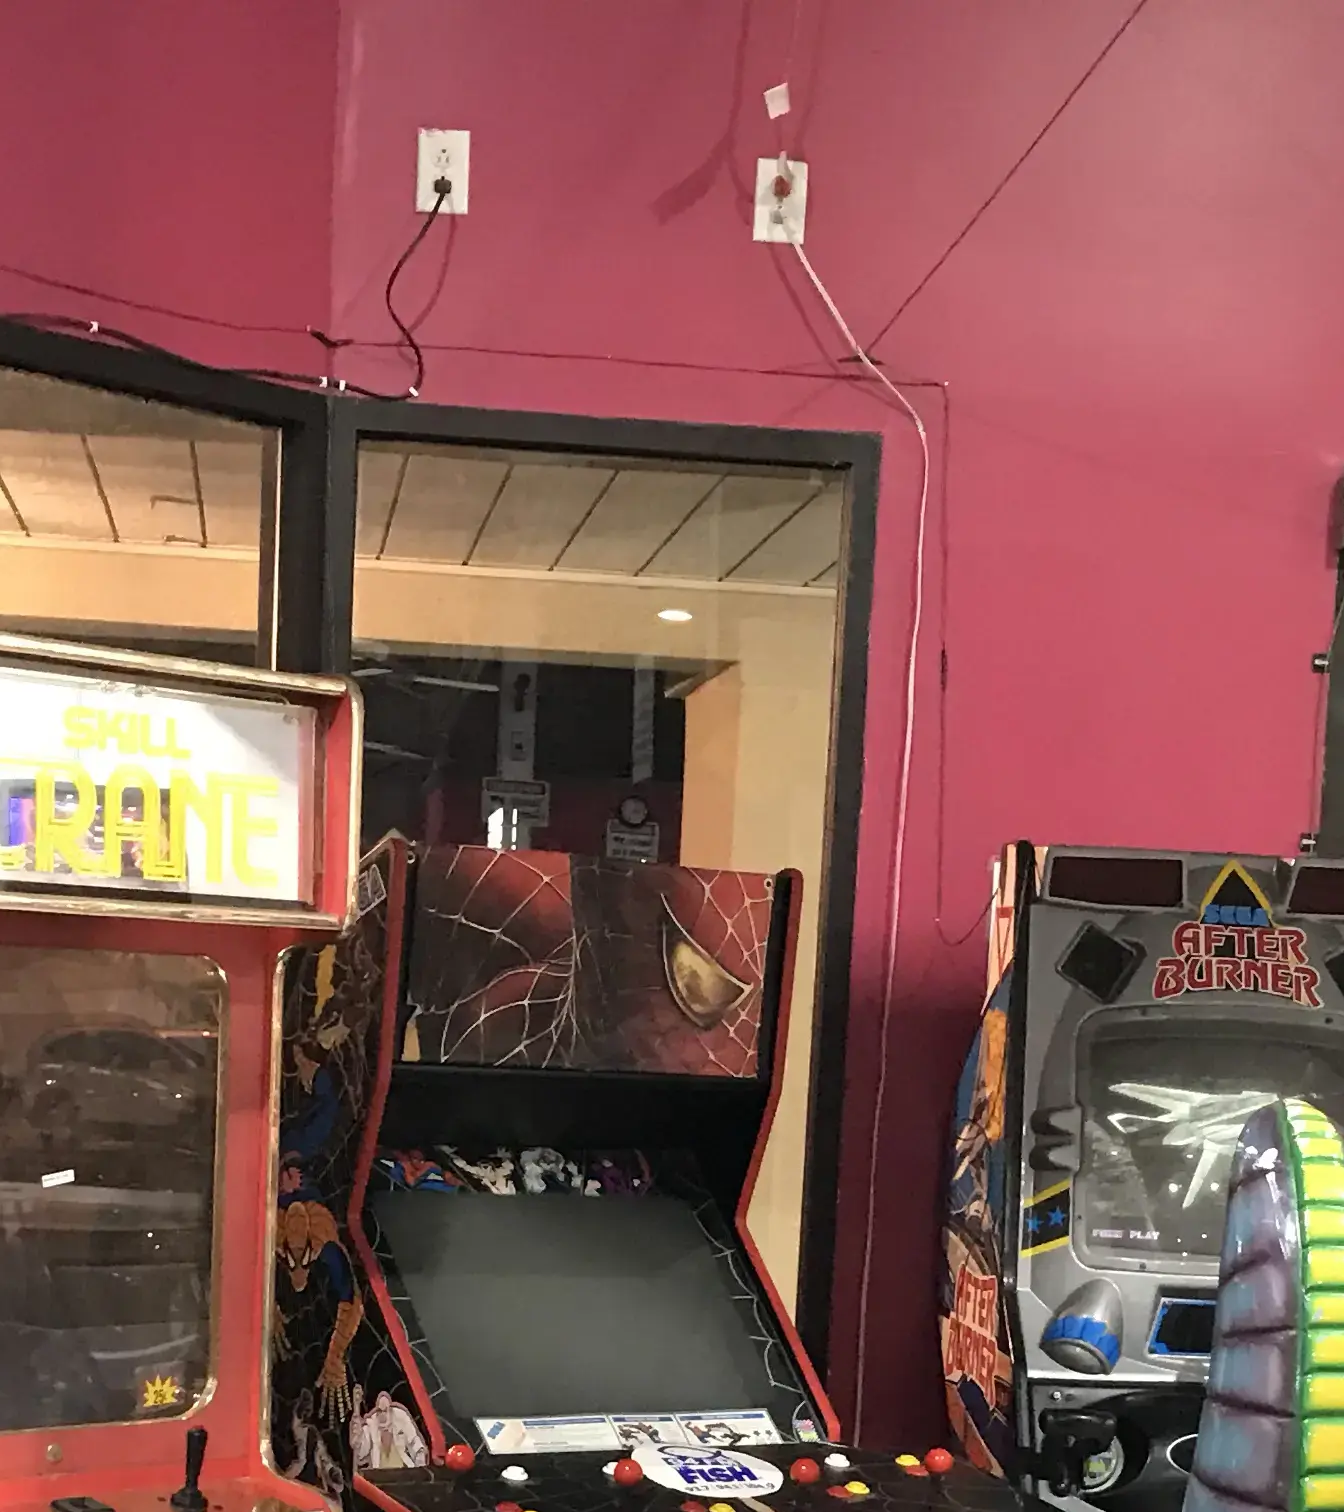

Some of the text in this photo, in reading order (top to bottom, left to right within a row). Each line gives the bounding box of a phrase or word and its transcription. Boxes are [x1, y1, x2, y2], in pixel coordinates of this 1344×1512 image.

[63, 706, 192, 759] SKILL
[1173, 921, 1309, 965] AFTER
[1152, 956, 1324, 1009] BURNER
[955, 1263, 999, 1340] AFTER
[944, 1316, 997, 1411] BURNER
[678, 1466, 758, 1484] FISH
